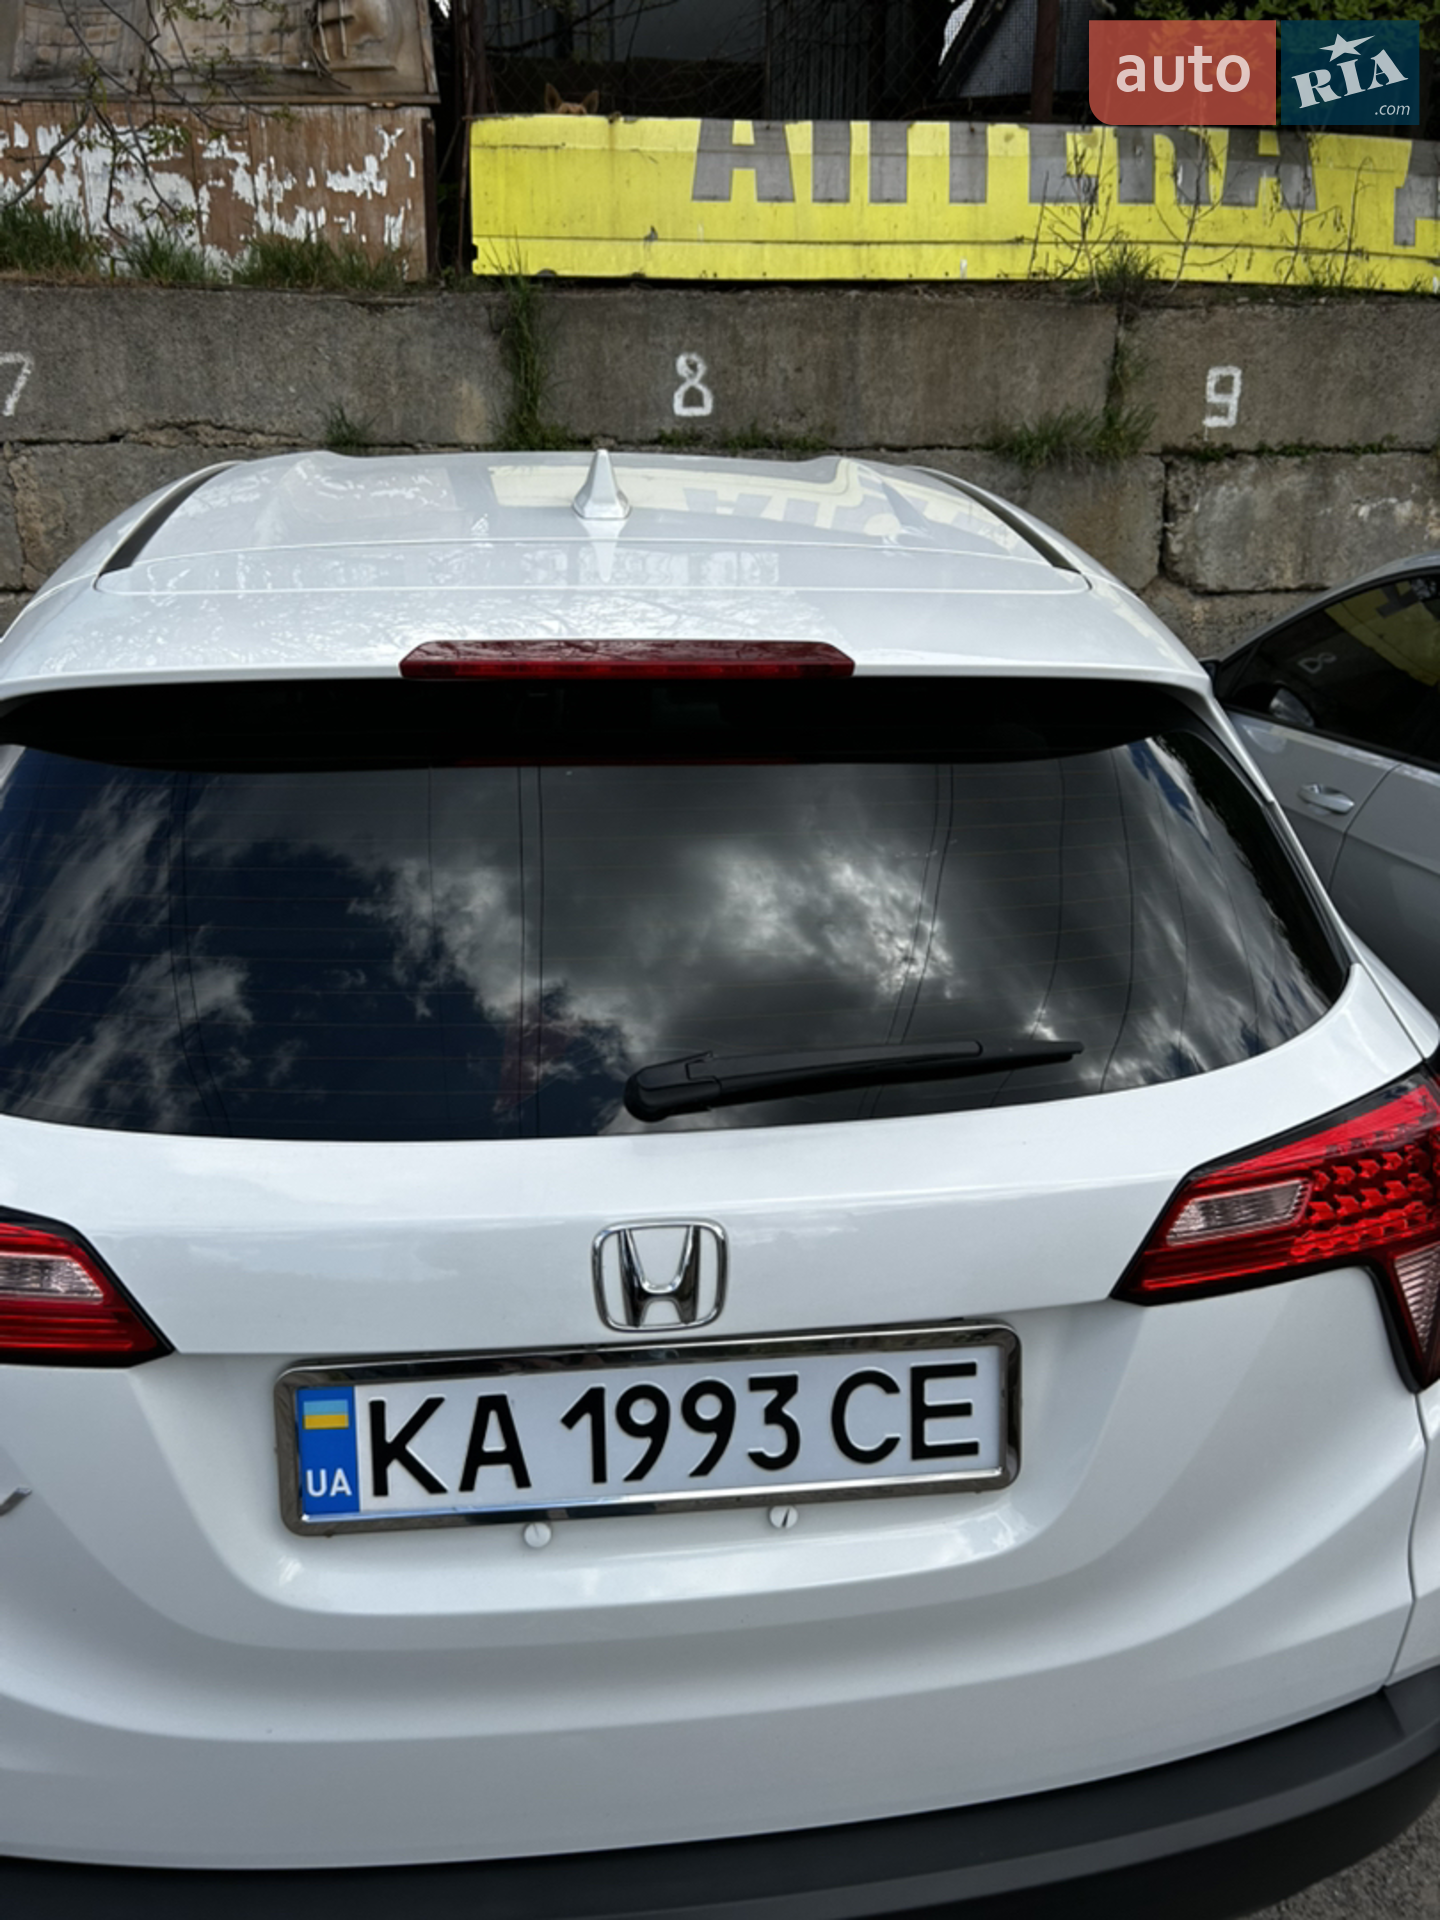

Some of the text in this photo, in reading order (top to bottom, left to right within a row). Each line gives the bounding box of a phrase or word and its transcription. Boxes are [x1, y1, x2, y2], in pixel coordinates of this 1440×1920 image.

[673, 353, 713, 416] 8
[1202, 365, 1241, 429] 9
[368, 1361, 981, 1497] KA 1993 CE
[306, 1467, 352, 1498] UA
